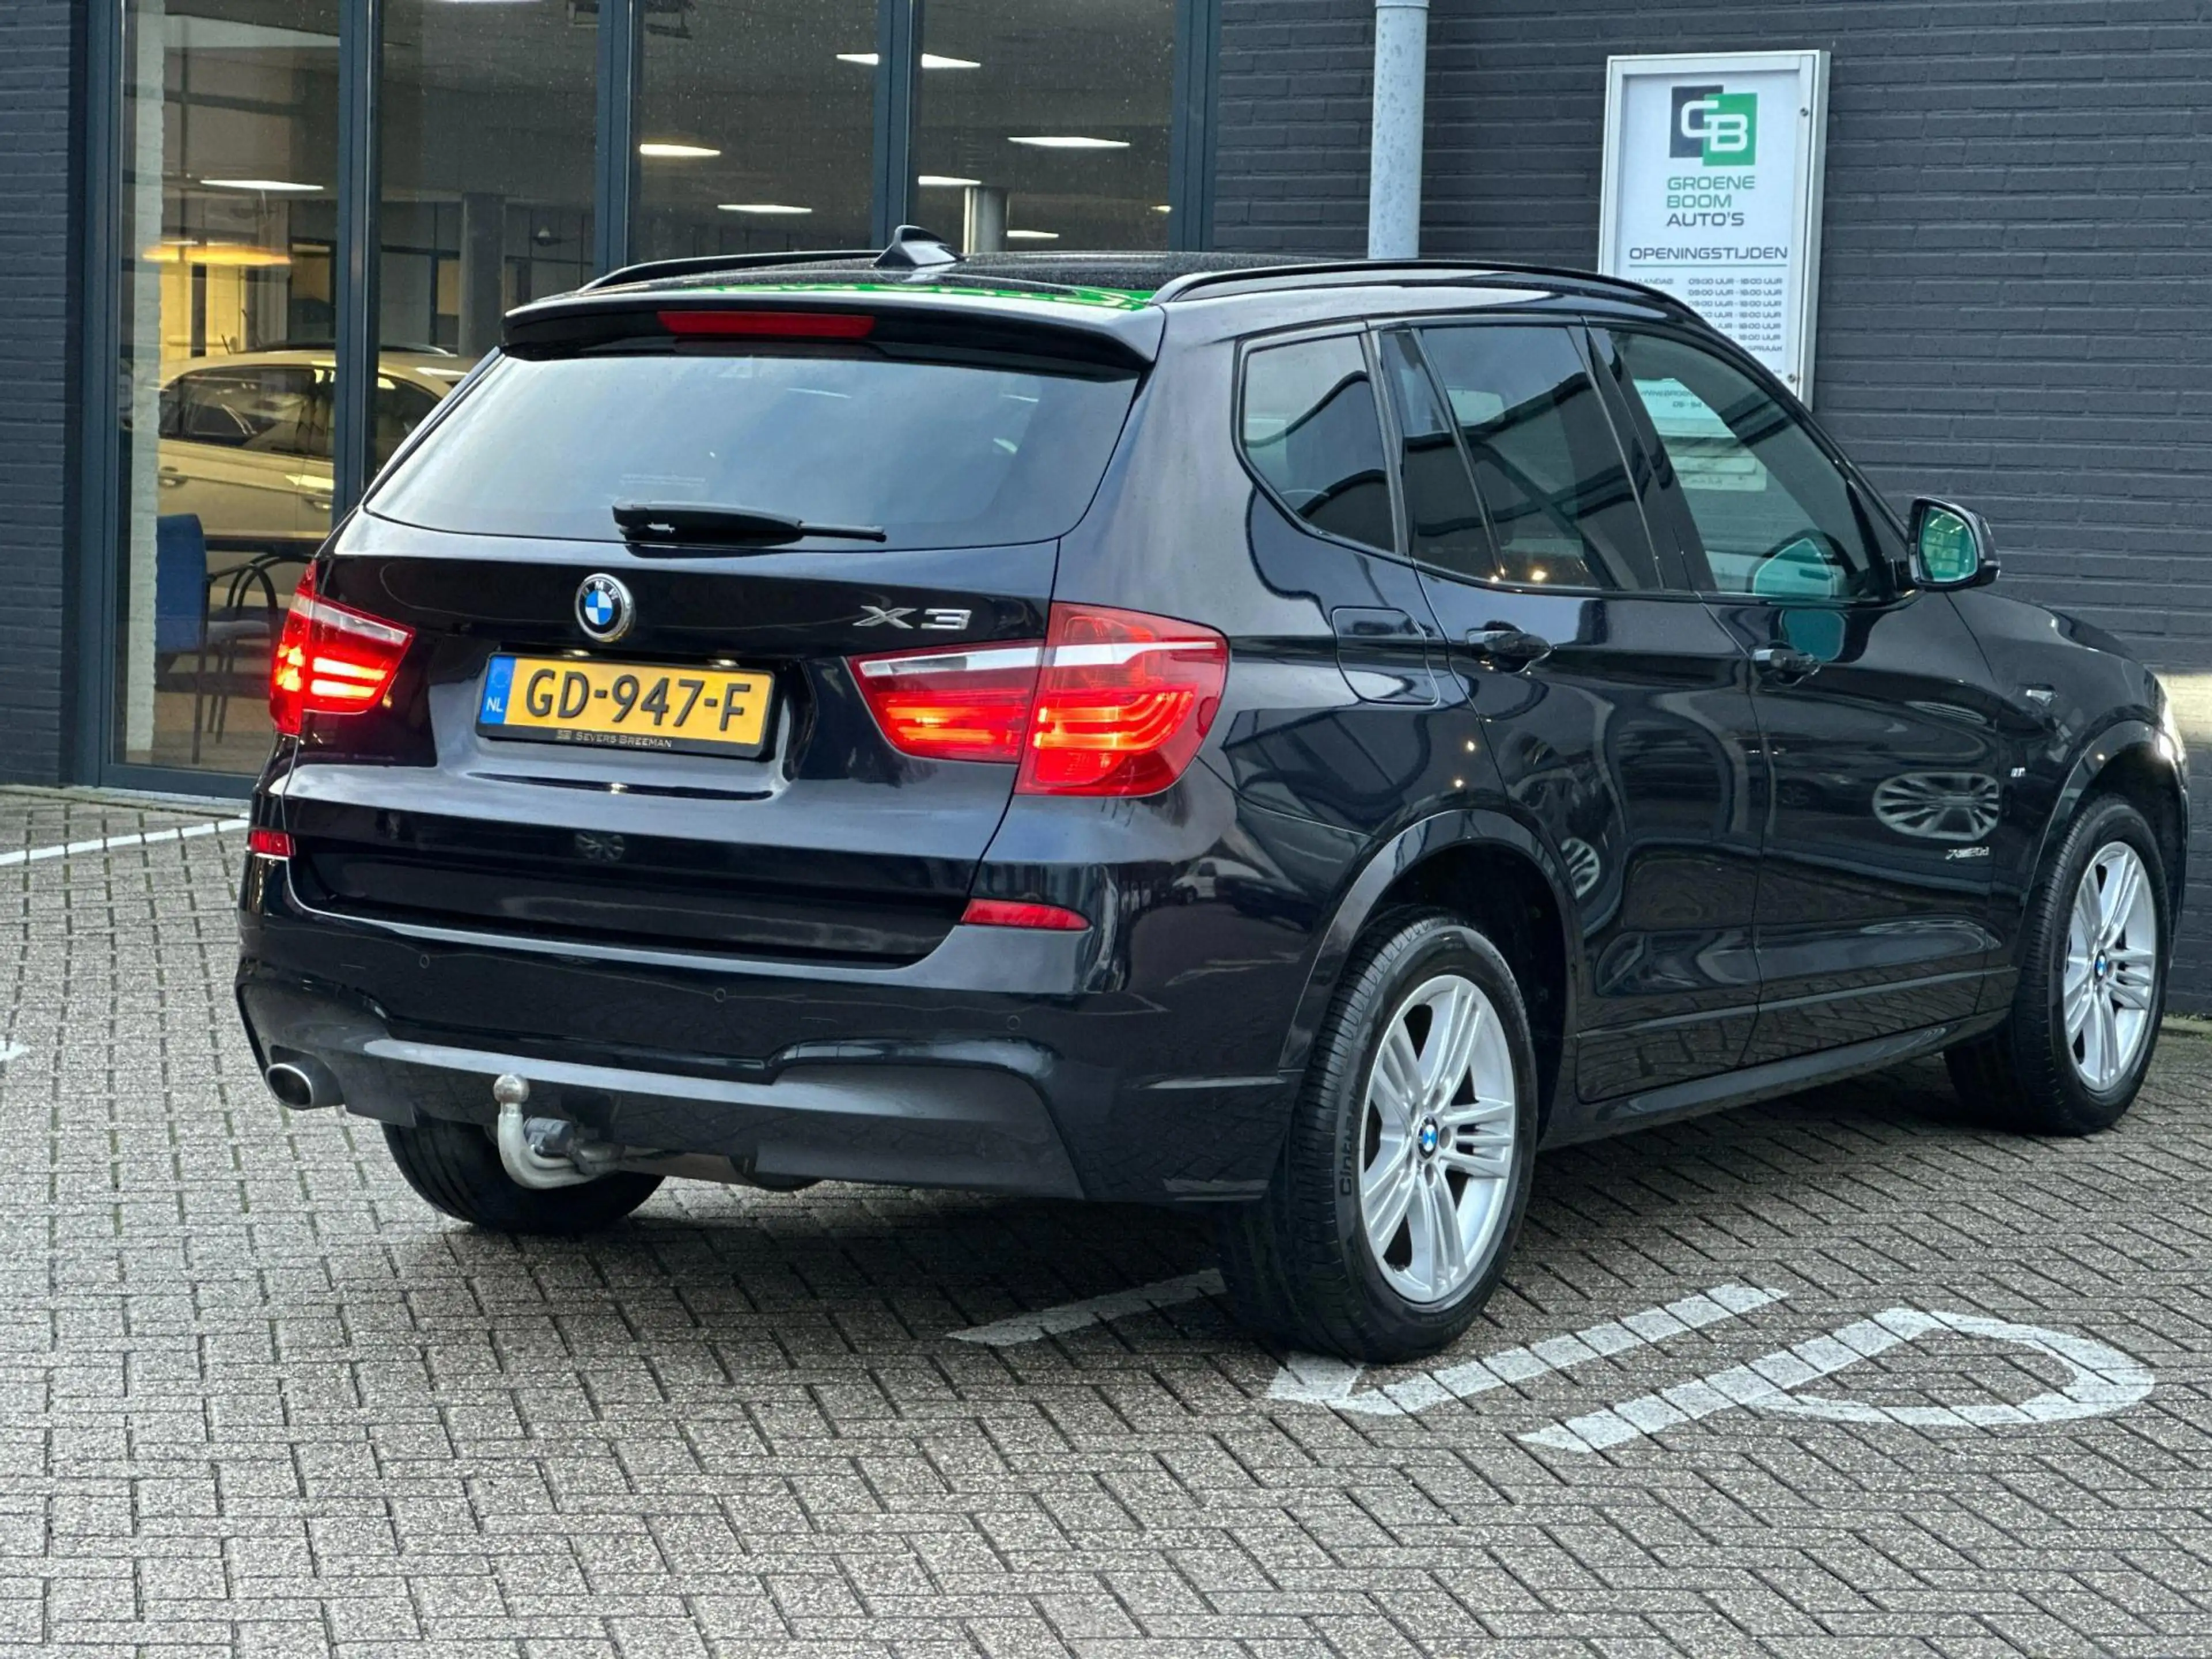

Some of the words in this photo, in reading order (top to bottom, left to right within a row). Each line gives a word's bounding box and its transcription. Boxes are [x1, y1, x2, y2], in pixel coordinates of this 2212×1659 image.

[1667, 176, 1755, 190] GROENE
[1666, 194, 1732, 209] BOOM
[1666, 211, 1744, 228] AUTO'S
[1629, 247, 1788, 260] OPENINGSTIJDEN
[853, 605, 972, 630] X3
[486, 696, 504, 713] NL
[526, 668, 751, 731] GD-947-F
